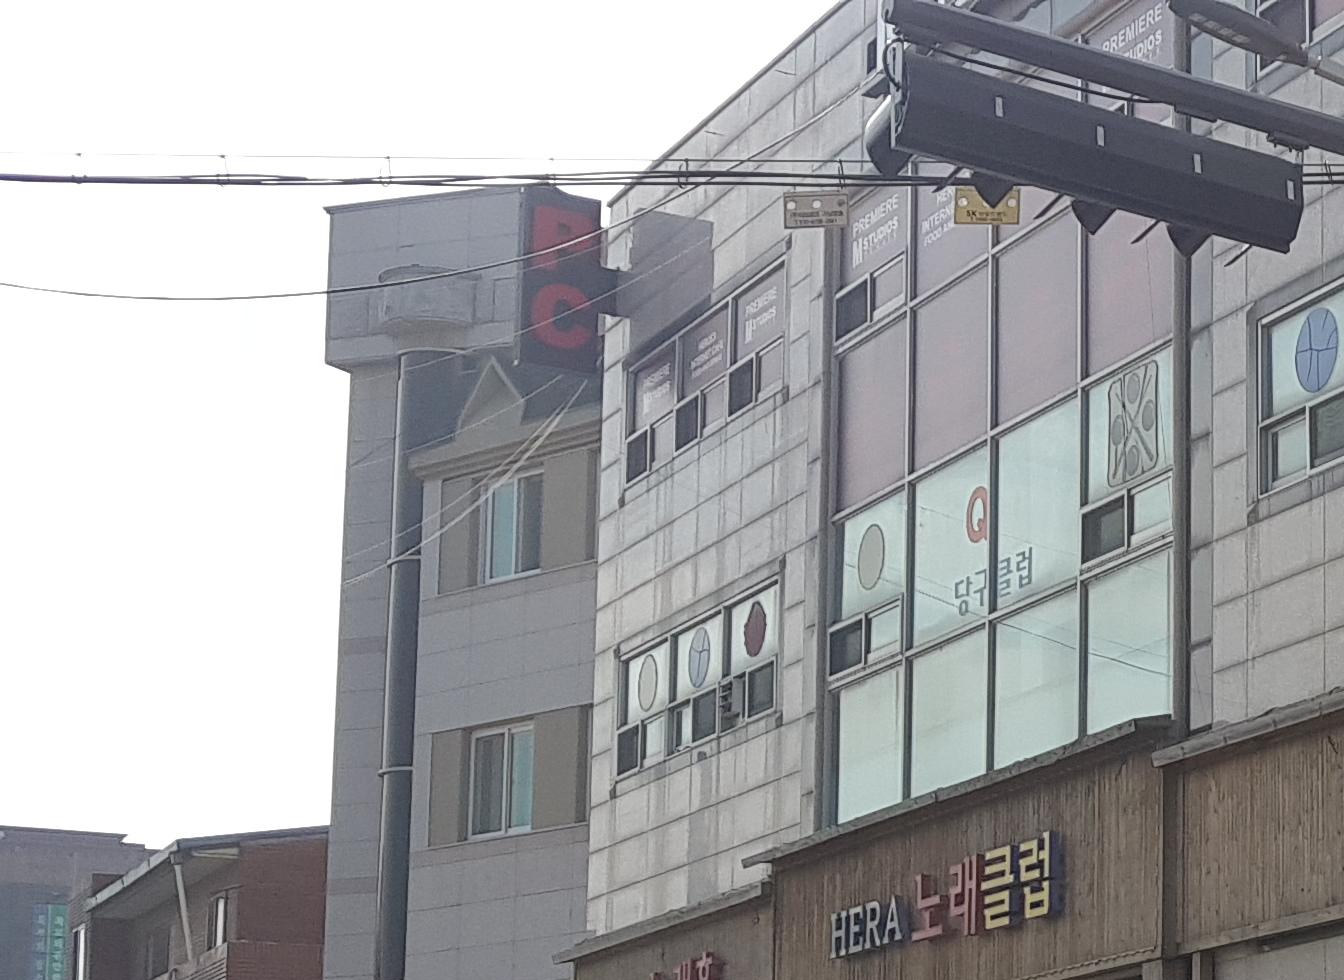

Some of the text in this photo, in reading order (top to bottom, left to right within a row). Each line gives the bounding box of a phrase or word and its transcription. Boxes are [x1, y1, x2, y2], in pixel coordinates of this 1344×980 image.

[1103, 3, 1162, 52] PREMIERE
[1123, 29, 1162, 59] UDIOS
[852, 194, 899, 238] PREMIERE
[921, 203, 954, 234] INTERN
[966, 486, 989, 543] Q
[954, 547, 1033, 617] 당구클럽
[830, 829, 1052, 961] HERA 노래클럽
